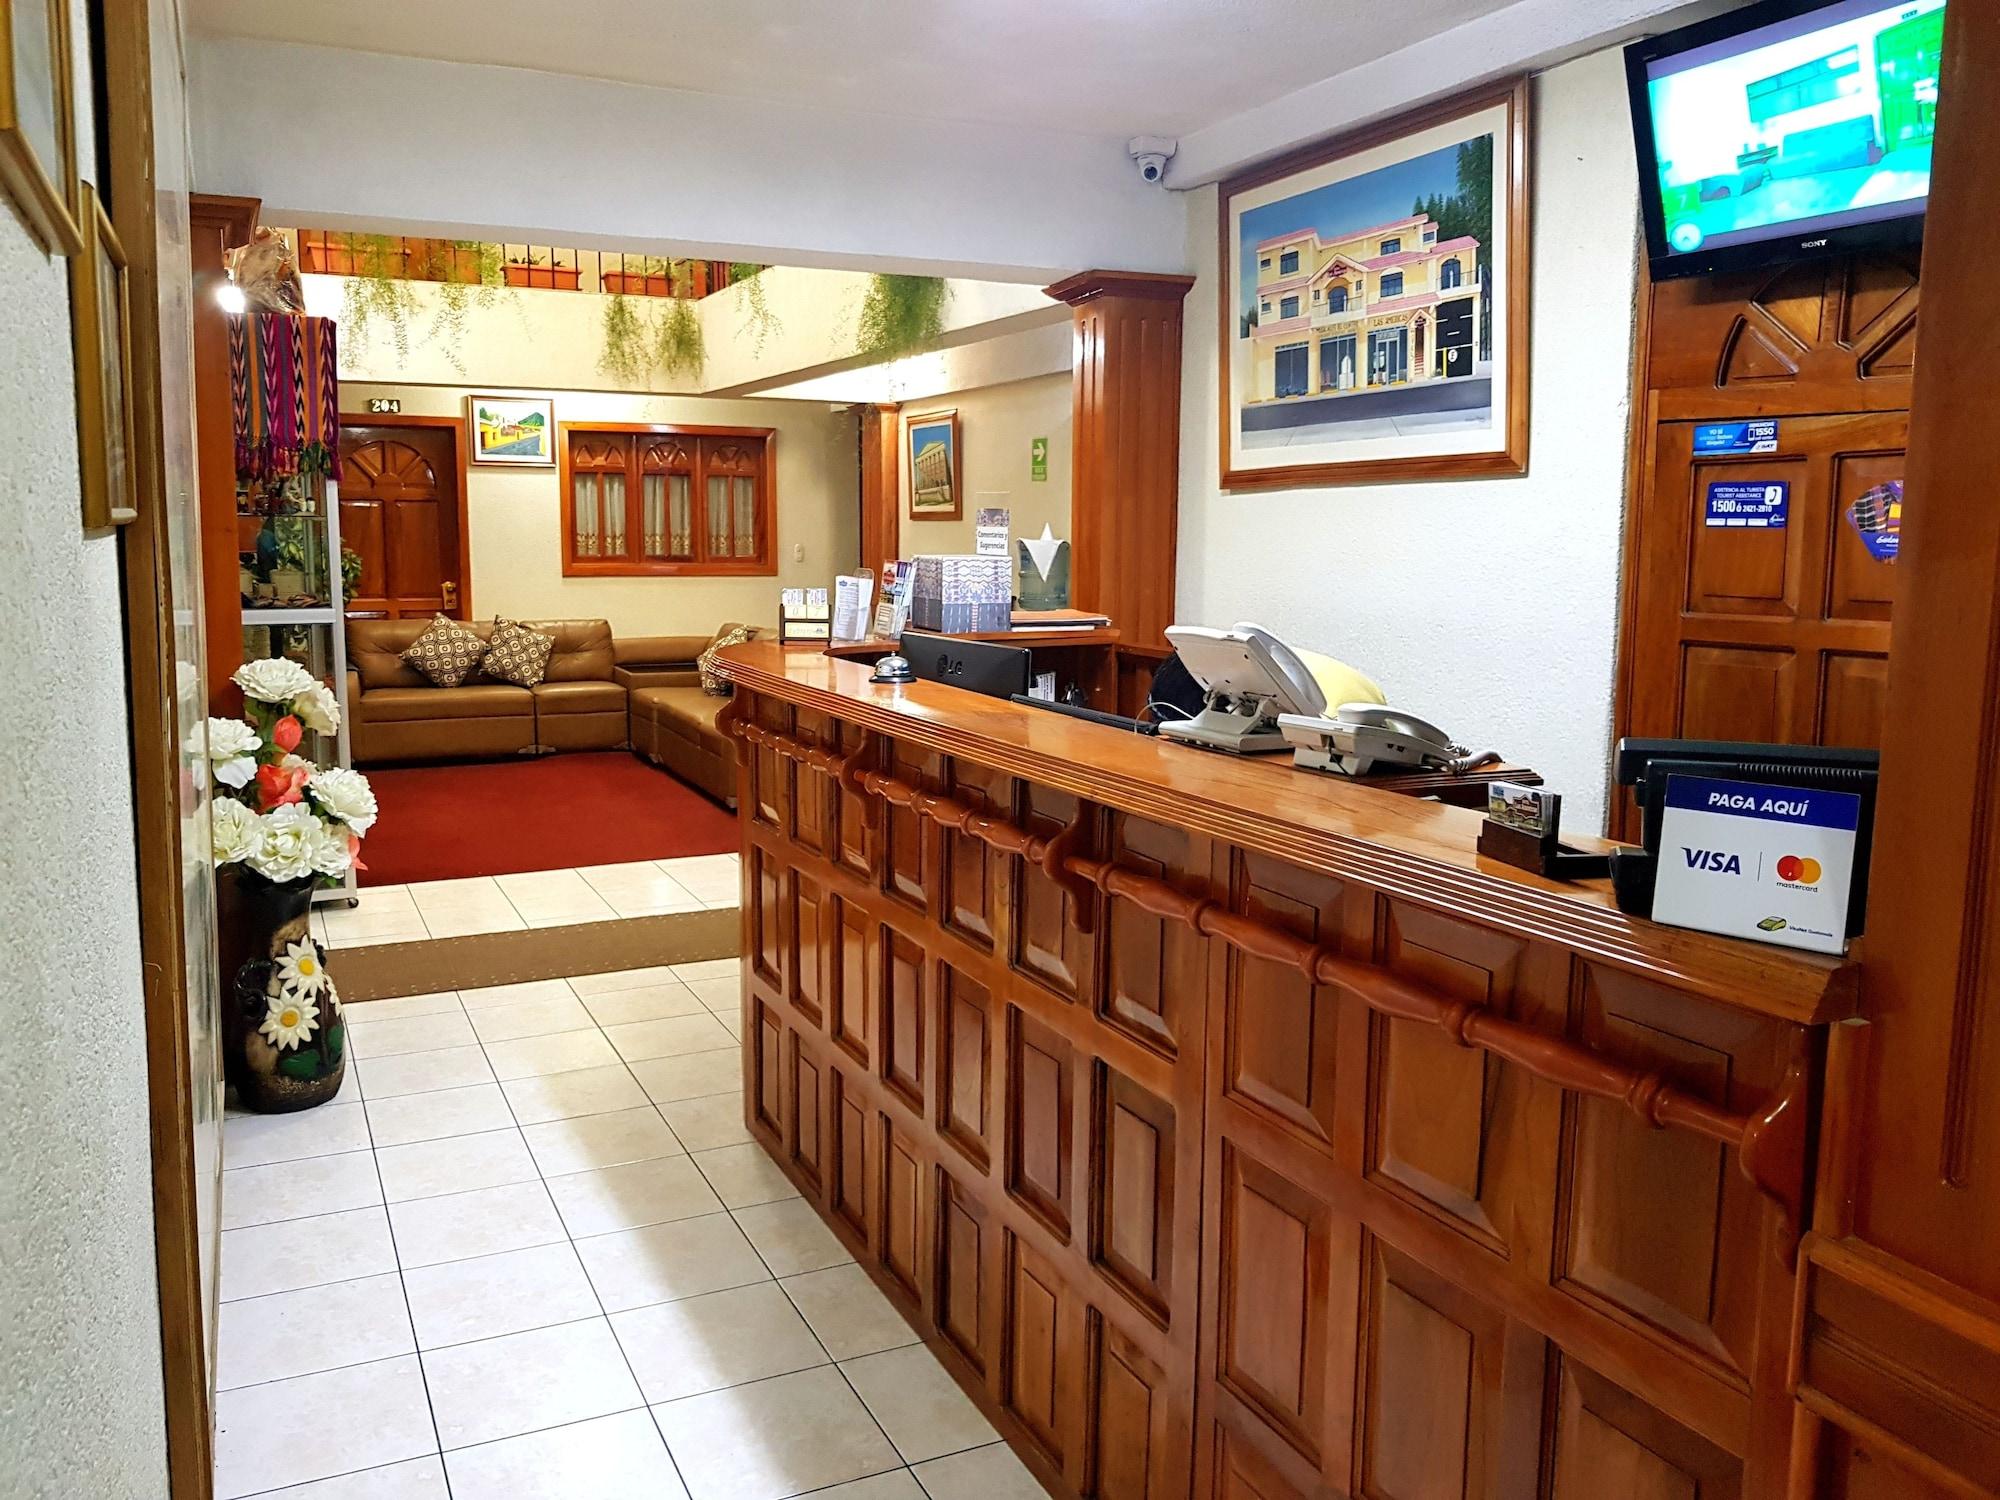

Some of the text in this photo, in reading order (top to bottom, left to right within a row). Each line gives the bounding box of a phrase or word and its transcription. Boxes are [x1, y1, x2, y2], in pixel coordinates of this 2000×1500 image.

[1801, 239, 1827, 249] SONY
[371, 399, 399, 413] 204
[1755, 427, 1775, 436] 1550
[1711, 500, 1736, 513] 1500
[1708, 792, 1810, 817] PAGA AQUÍ
[1680, 846, 1741, 875] VISA
[1776, 881, 1818, 893] mastercard
